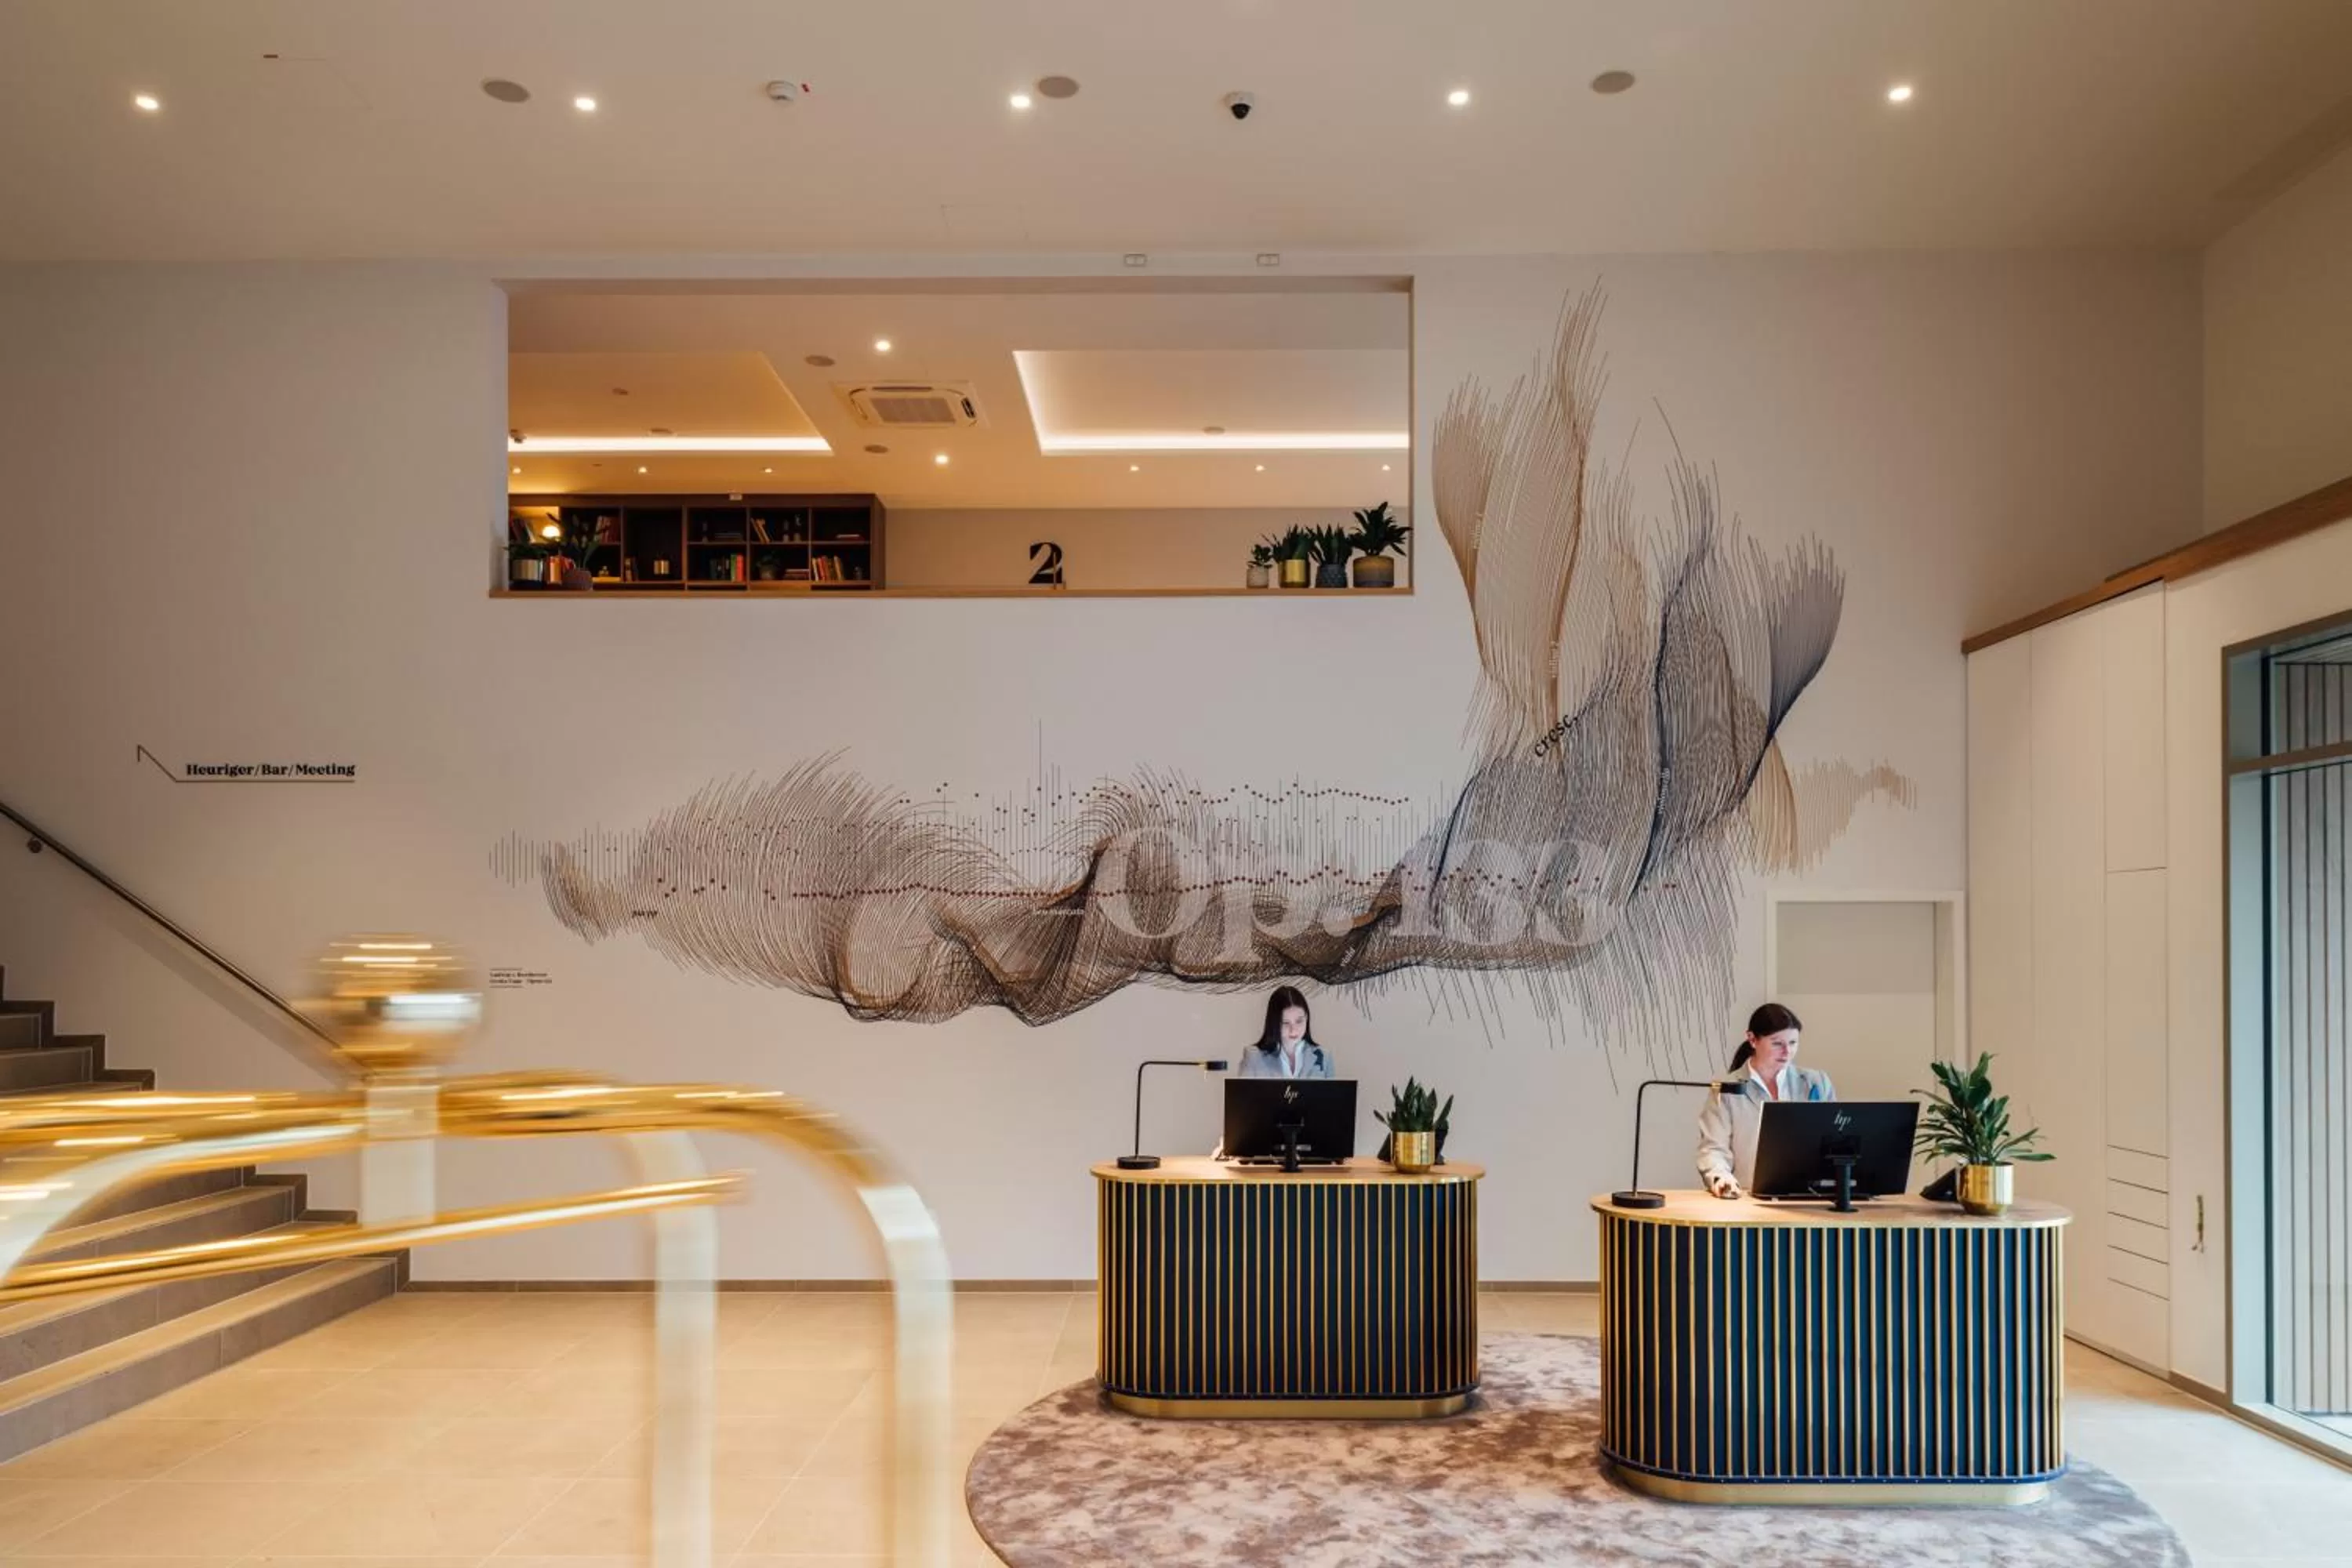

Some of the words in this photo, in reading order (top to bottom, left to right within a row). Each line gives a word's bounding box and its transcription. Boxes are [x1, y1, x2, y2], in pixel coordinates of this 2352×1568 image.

[1029, 542, 1062, 584] 2
[1283, 1085, 1298, 1104] hp
[1834, 1109, 1851, 1131] hp
